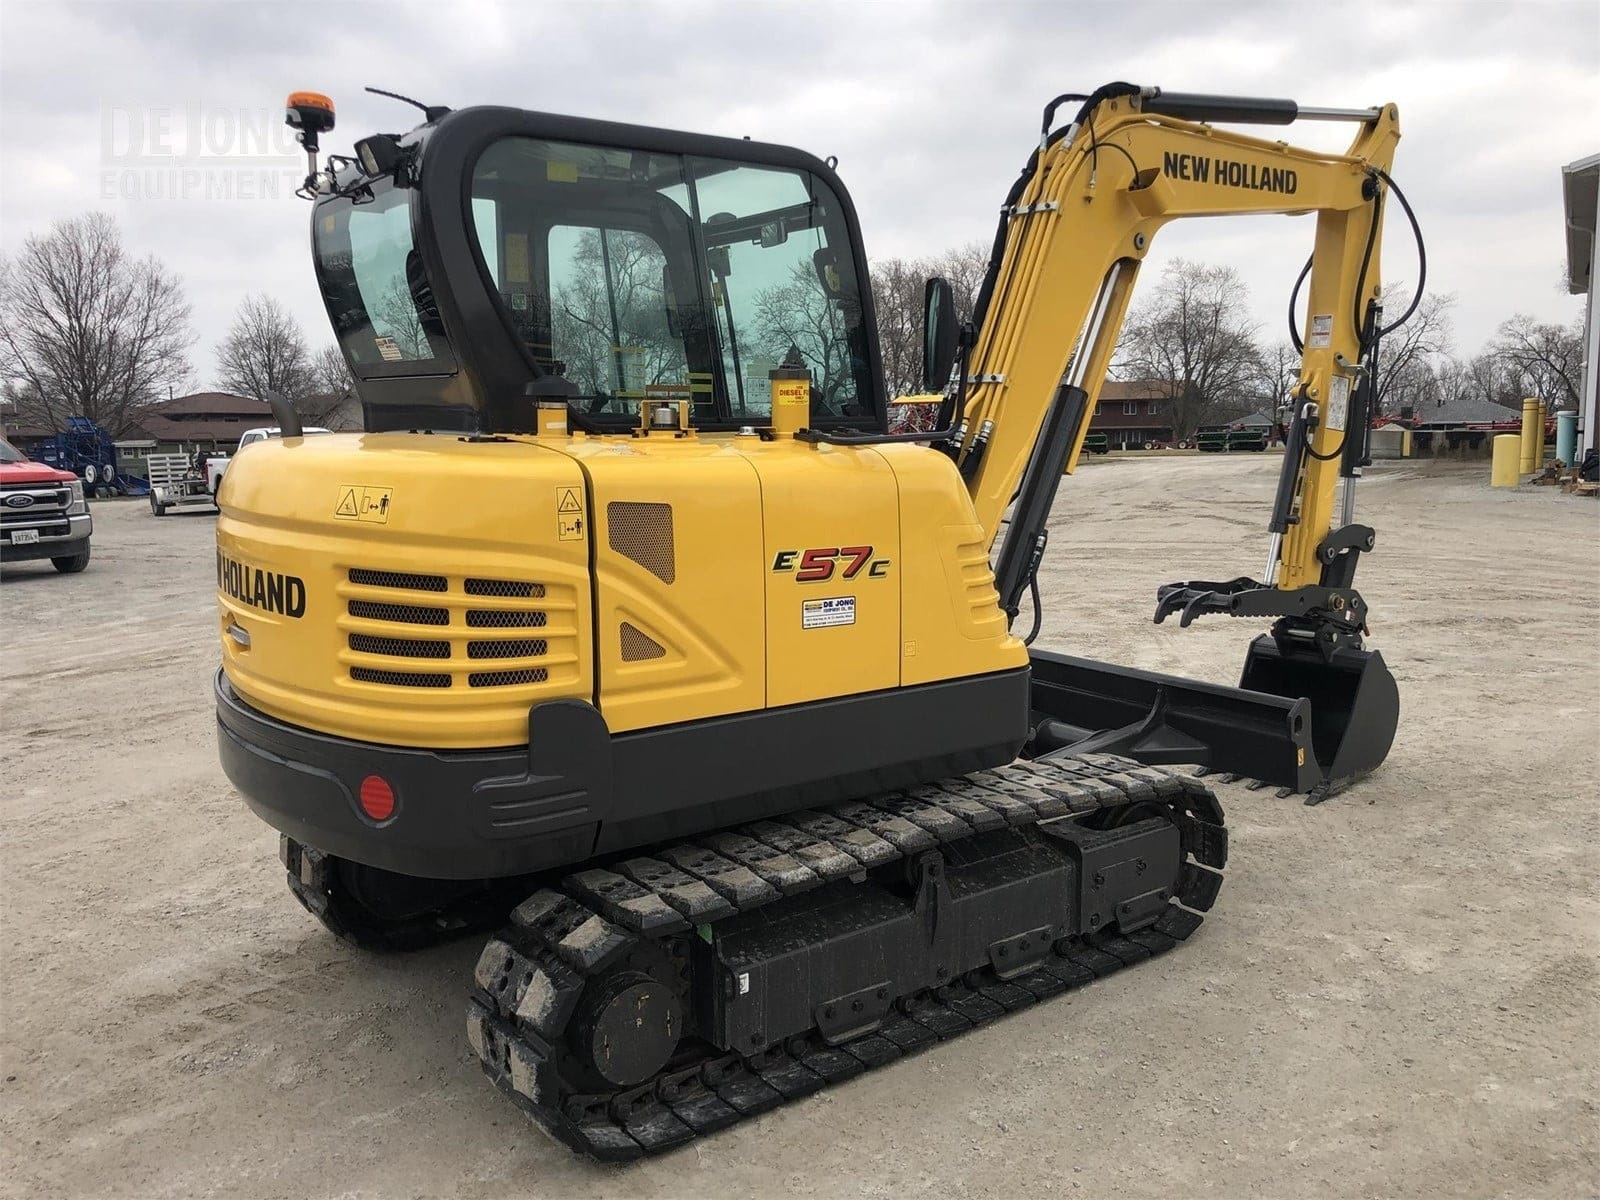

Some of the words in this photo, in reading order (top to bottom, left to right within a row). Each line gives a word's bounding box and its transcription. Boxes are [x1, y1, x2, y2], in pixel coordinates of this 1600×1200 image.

[1164, 152, 1210, 183] NEW
[1214, 159, 1298, 195] HOLLAND
[222, 555, 306, 618] HOLLAND
